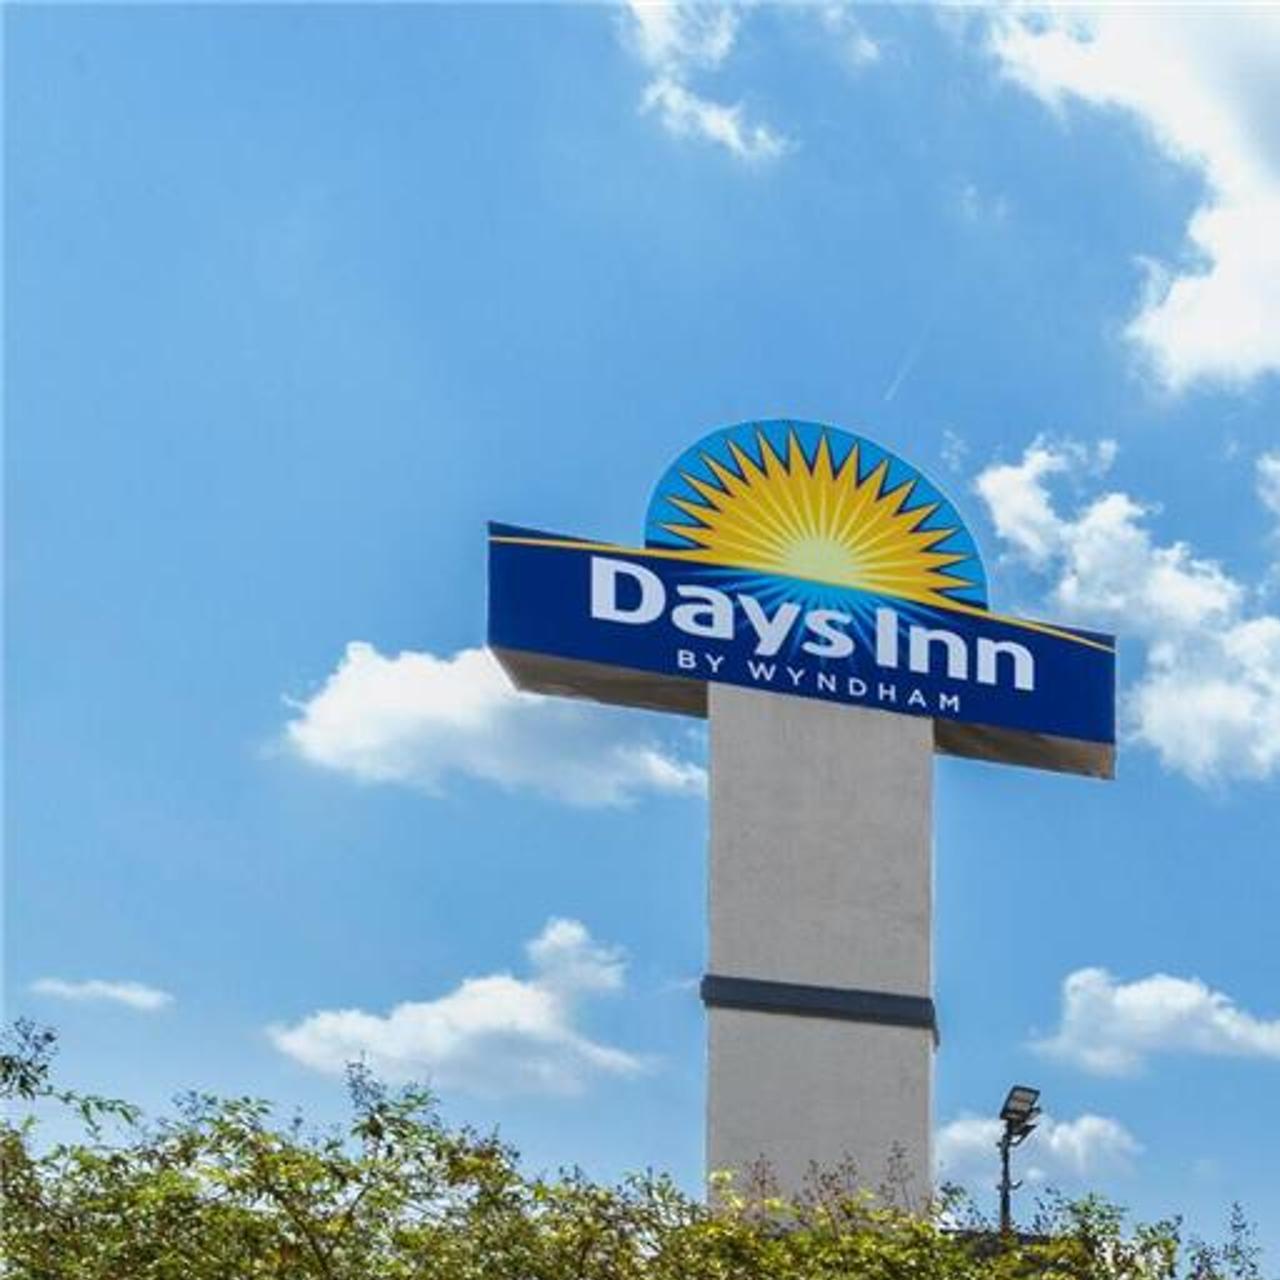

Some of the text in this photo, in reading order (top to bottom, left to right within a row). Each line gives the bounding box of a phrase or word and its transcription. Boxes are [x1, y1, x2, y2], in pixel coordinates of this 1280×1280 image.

[591, 555, 1035, 692] Days Inn
[677, 649, 960, 712] BY WYNDHAM
